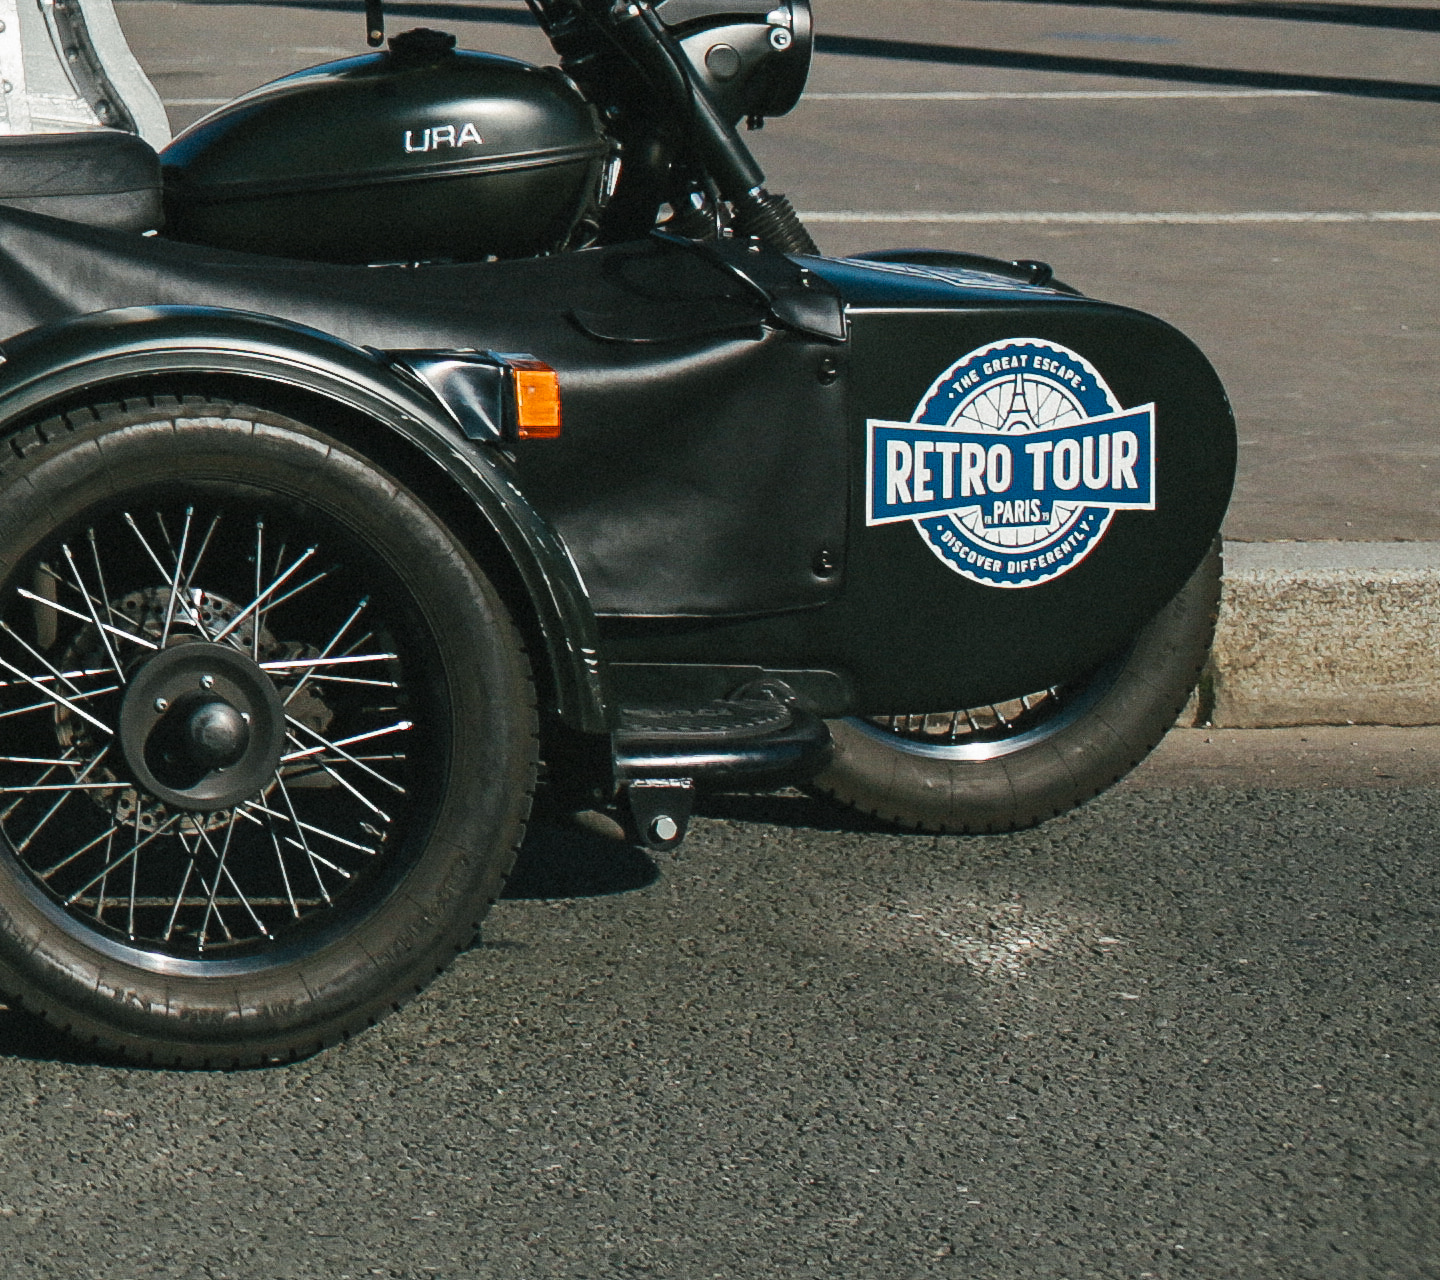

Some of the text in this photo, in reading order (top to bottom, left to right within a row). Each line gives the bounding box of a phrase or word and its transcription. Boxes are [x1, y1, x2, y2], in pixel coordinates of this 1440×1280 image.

[403, 122, 484, 153] URA
[952, 354, 1083, 393] THE GREAT ESCAPE
[886, 430, 1139, 506] RETRO TOUR
[993, 497, 1041, 525] PARIS
[941, 519, 1091, 575] DISCOVER DIFFERENTLY
